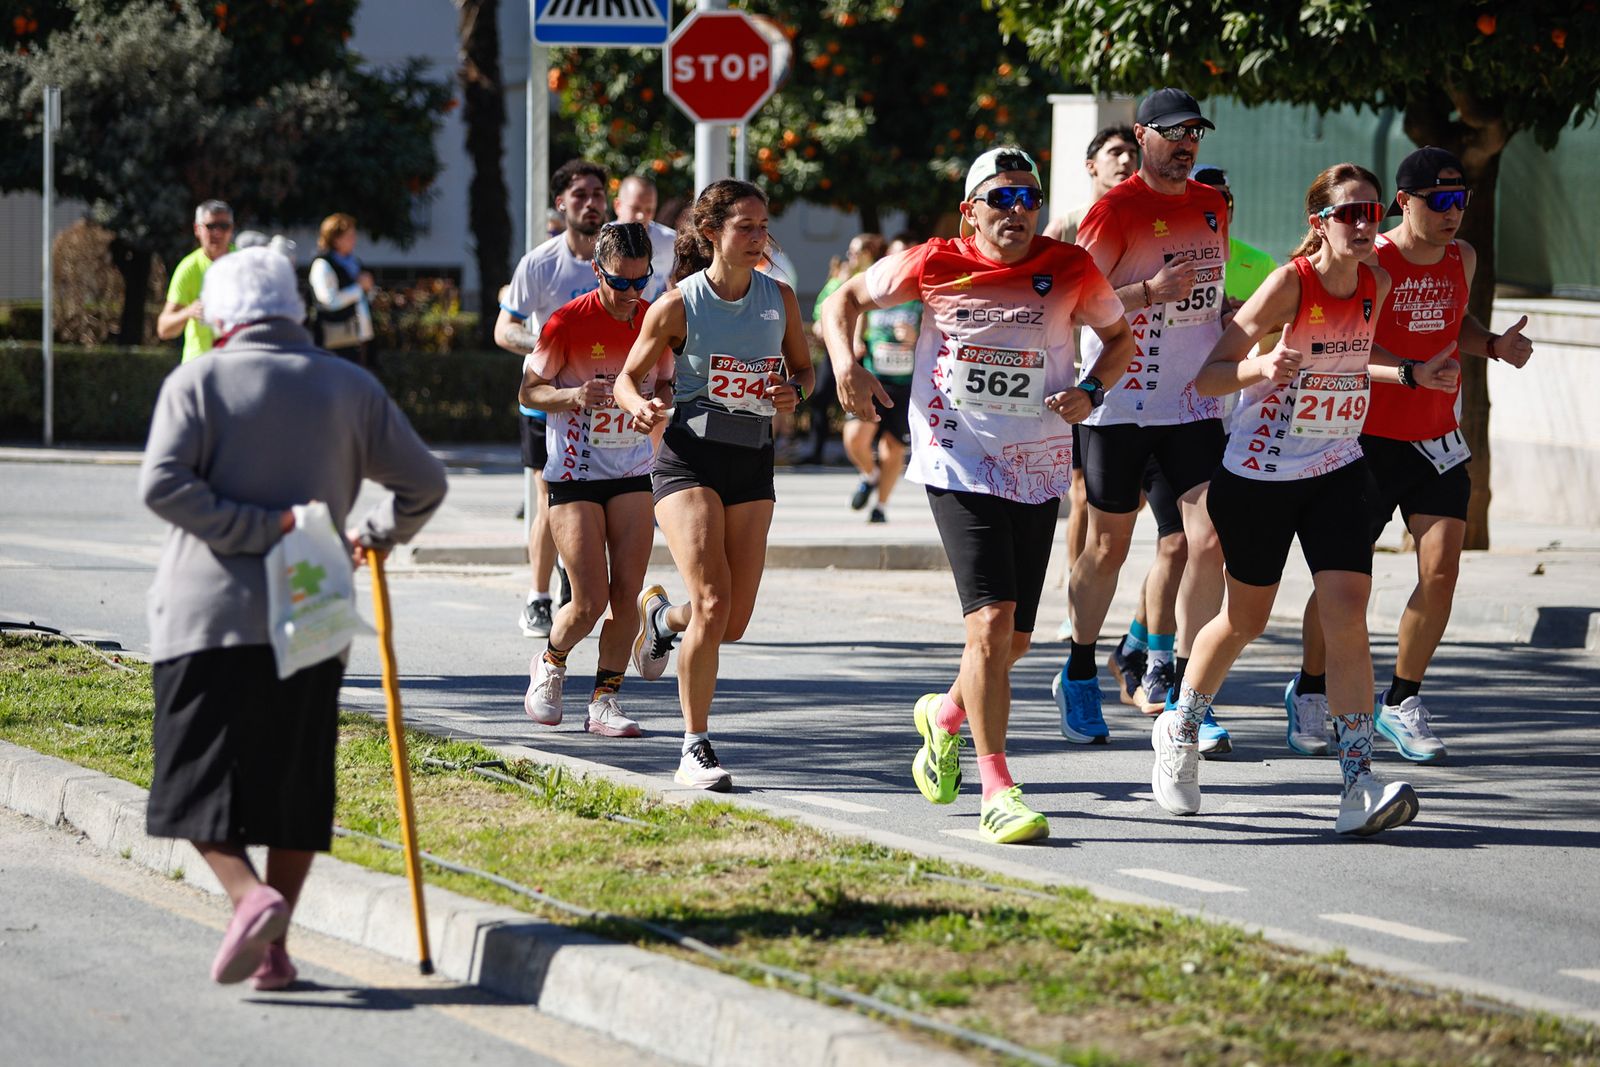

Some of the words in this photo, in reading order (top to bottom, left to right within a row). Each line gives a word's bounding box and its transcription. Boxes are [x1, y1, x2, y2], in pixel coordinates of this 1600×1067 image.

[674, 53, 768, 83] STOP
[961, 348, 977, 360] 39
[976, 353, 1024, 366] FONDO
[716, 359, 731, 369] 39
[730, 362, 768, 372] FONDO
[711, 375, 769, 400] 234
[965, 368, 1030, 398] 562
[1306, 376, 1321, 387] 39
[1319, 380, 1358, 390] FONDO
[1296, 394, 1366, 421] 2149
